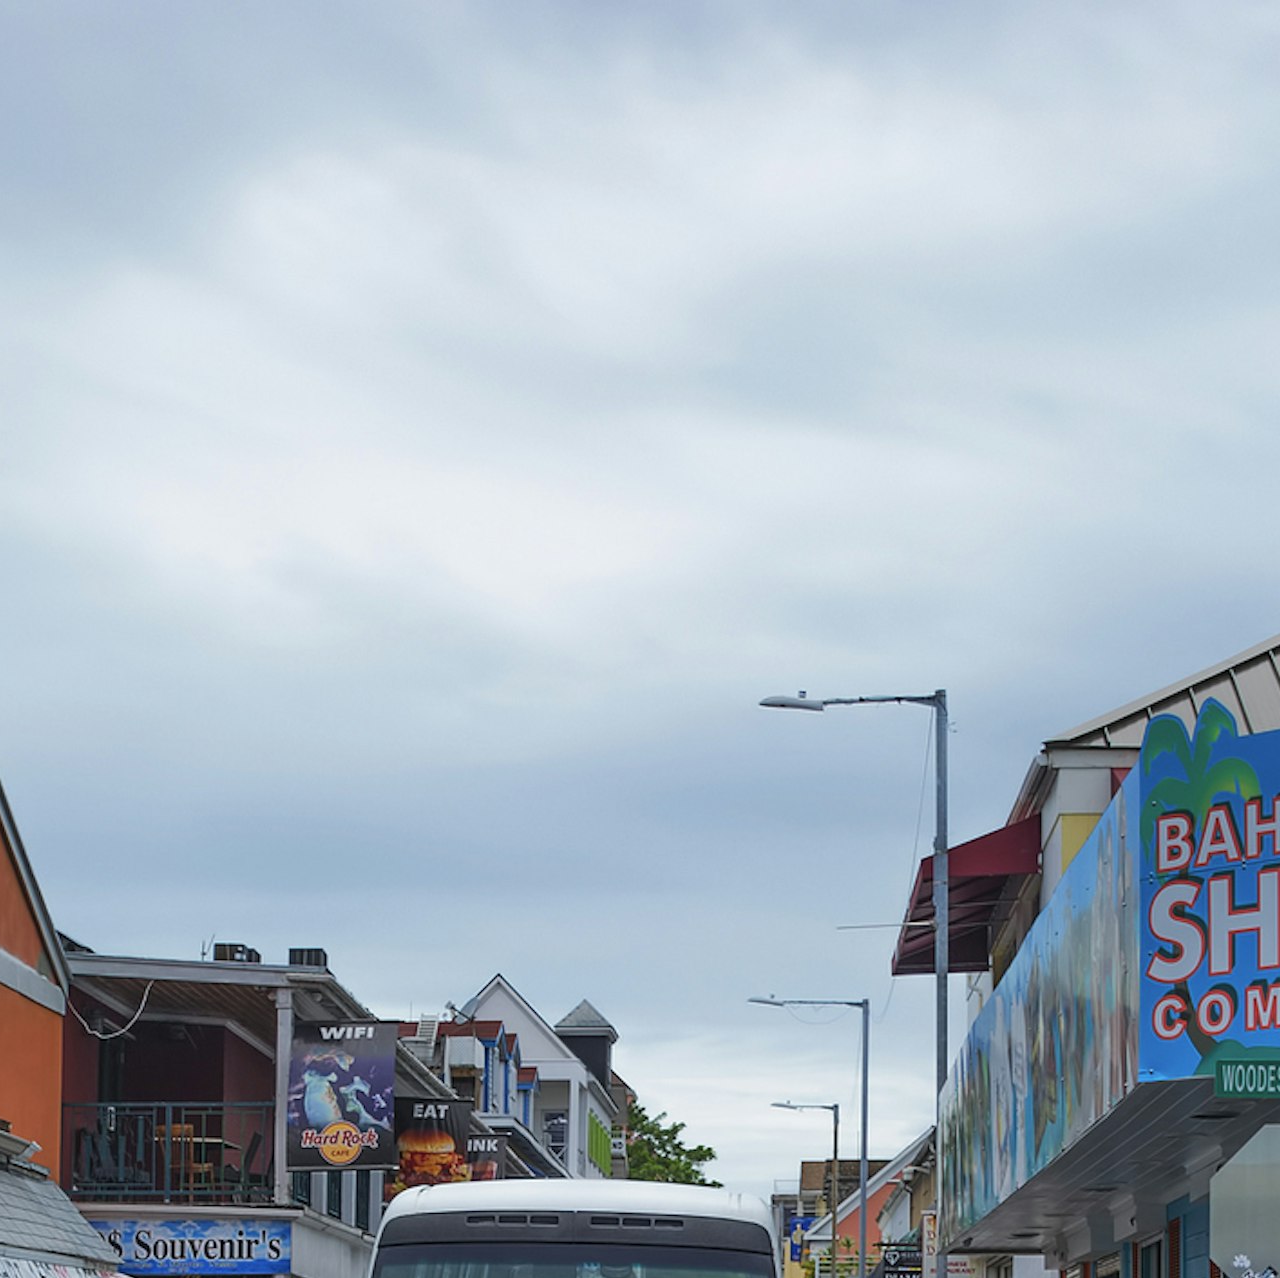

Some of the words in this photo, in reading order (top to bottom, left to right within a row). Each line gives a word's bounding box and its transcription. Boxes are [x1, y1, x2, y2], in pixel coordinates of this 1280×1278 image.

[320, 1026, 375, 1040] WIFI
[412, 1104, 450, 1120] EAT
[301, 1129, 342, 1149] Hard
[342, 1128, 379, 1149] Rock
[467, 1138, 498, 1152] INK
[134, 1229, 282, 1261] Souvenir's
